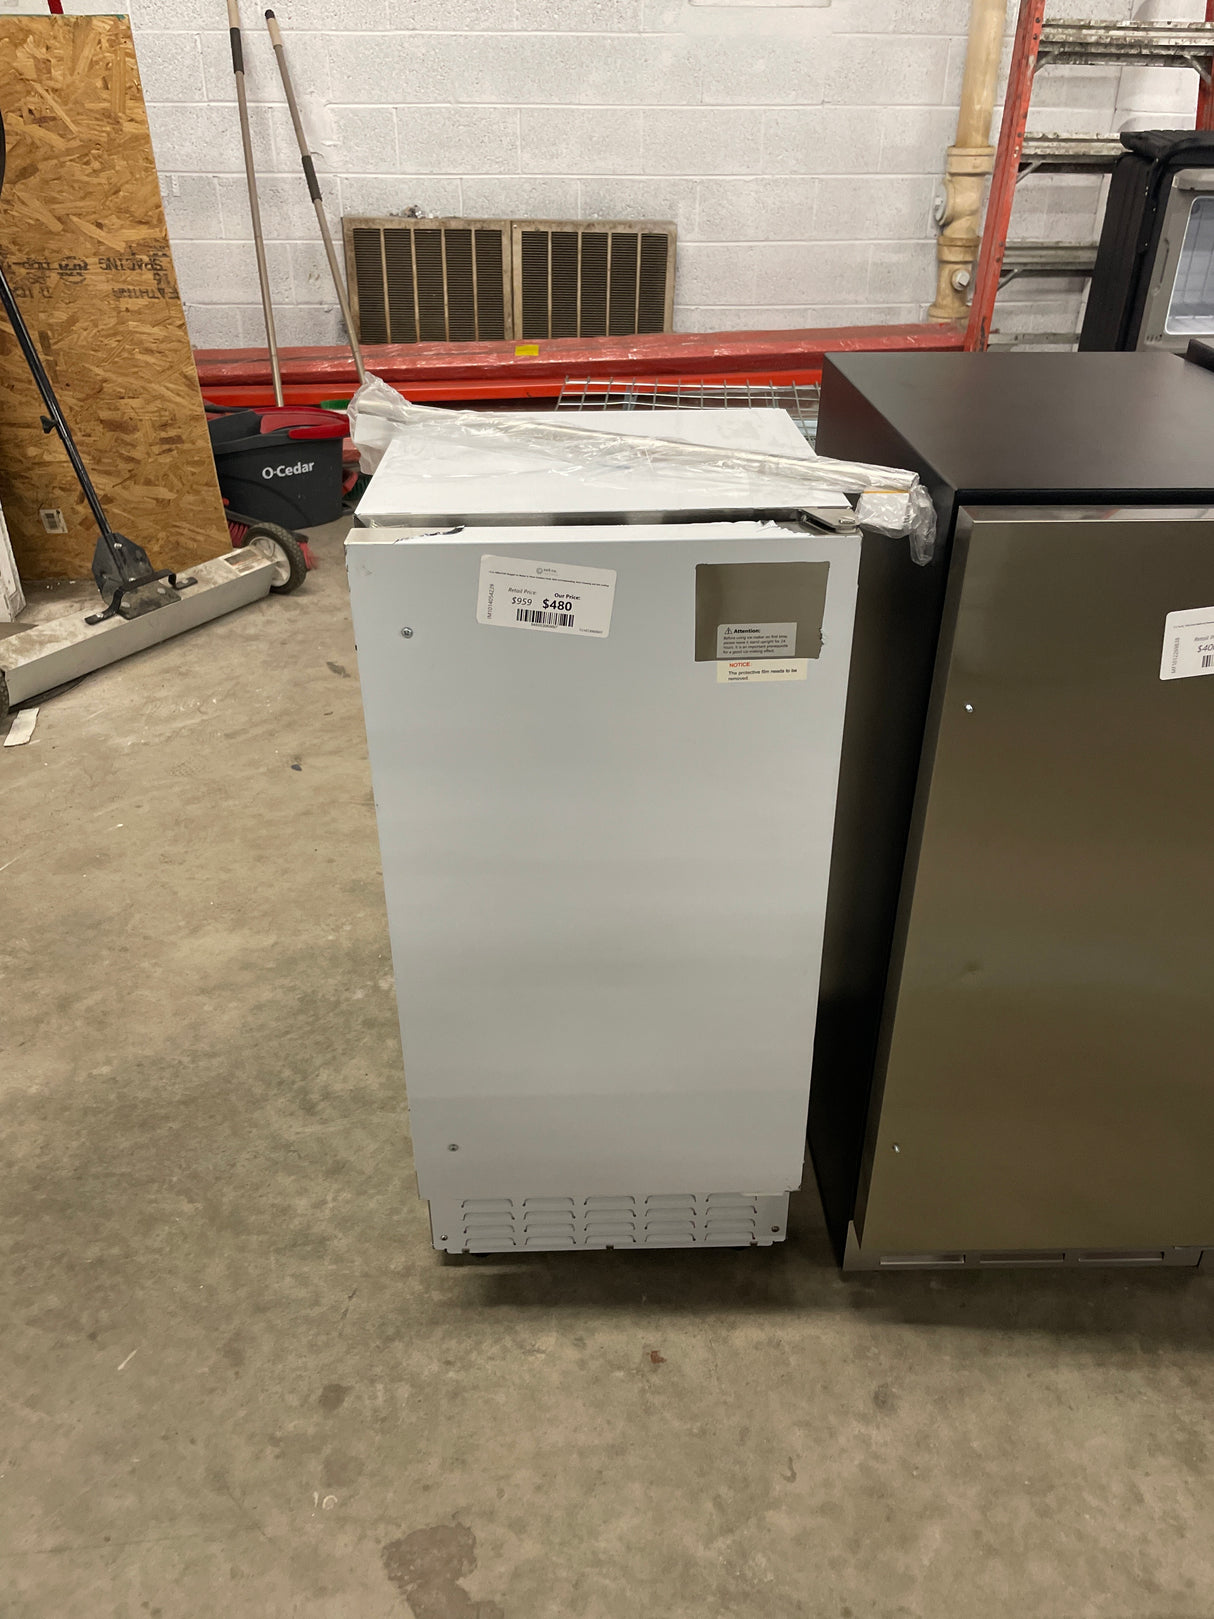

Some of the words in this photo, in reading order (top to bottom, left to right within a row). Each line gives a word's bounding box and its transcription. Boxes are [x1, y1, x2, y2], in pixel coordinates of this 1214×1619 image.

[98, 257, 165, 271] SPACING
[262, 462, 314, 479] O-Cedar
[512, 596, 532, 606] $959
[542, 598, 572, 611] $480
